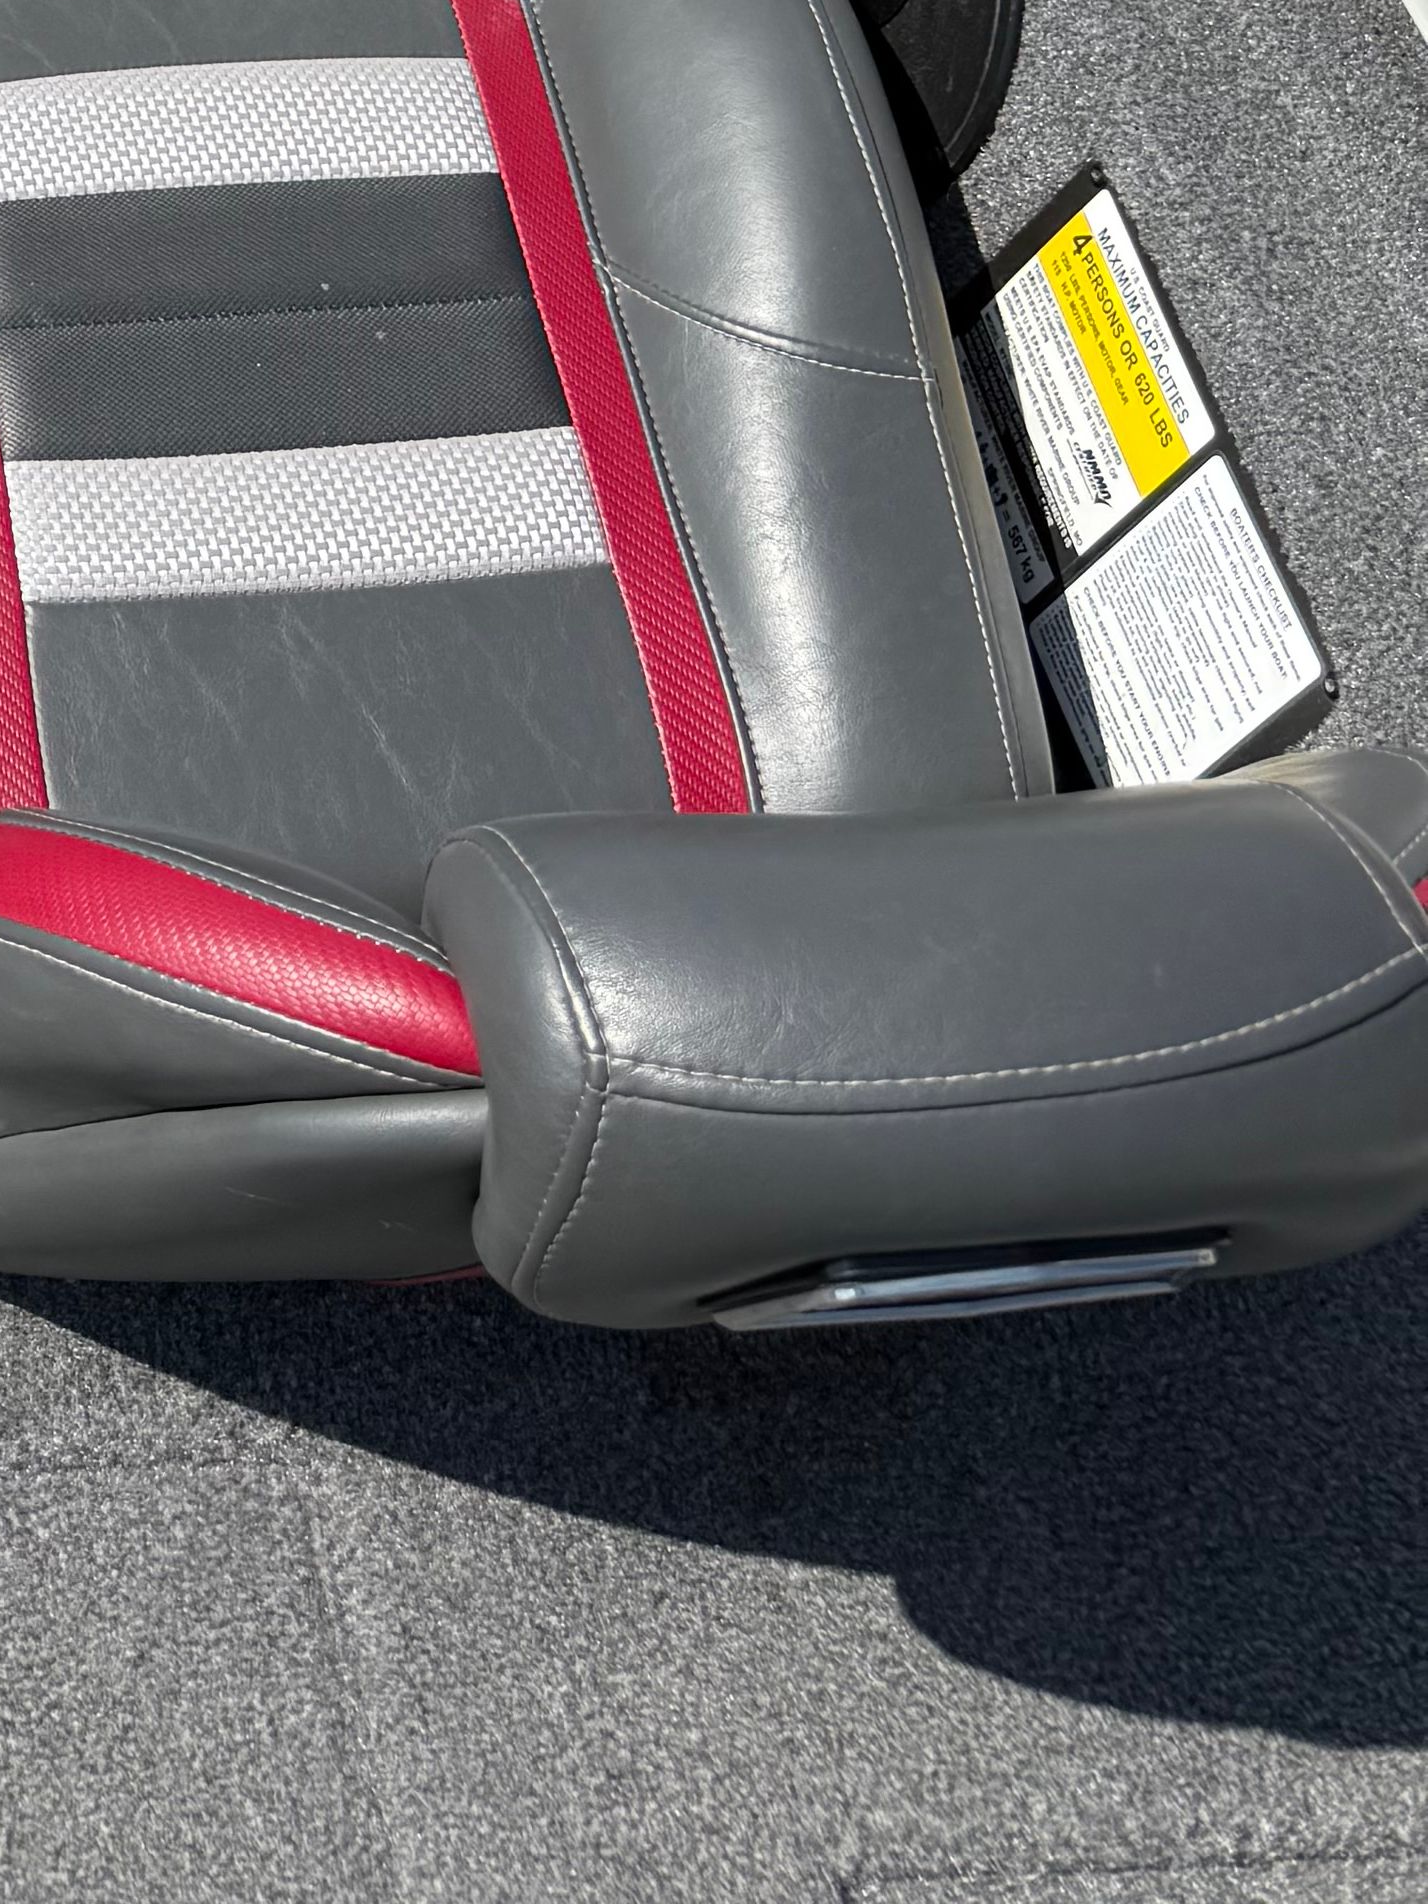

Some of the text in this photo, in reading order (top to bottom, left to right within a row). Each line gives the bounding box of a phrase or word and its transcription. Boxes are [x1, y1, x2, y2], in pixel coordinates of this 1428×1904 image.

[1002, 291, 1063, 431] USING CERTIFIED COMPONENTS
[1009, 284, 1026, 318] MEETS
[1029, 333, 1041, 355] EPA
[1048, 378, 1075, 436] STANDARDS
[1018, 275, 1050, 344] CERTIFICATION
[1025, 269, 1043, 305] SAFETY
[1040, 304, 1066, 360] STANDARDS
[1067, 369, 1086, 405] EFFECT
[1082, 404, 1092, 422] ON
[1089, 420, 1100, 441] THE
[1097, 439, 1112, 467] DATE
[1108, 466, 1118, 483] OF
[1032, 262, 1045, 285] THIS
[1041, 283, 1055, 310] BOAT
[1052, 308, 1075, 356] COMPLIES
[1071, 354, 1085, 381] WITH
[1089, 397, 1107, 432] COAST
[1103, 430, 1122, 467] GUARD
[1067, 223, 1174, 450] 4 PERSONS OR 620 LBS
[1068, 299, 1087, 335] MOTOR
[1096, 226, 1190, 426] MAXIMUM CAPACITIES
[1137, 284, 1155, 318] COAST
[1151, 317, 1170, 353] GUARD
[1023, 377, 1039, 408] WHITE
[1035, 406, 1050, 436] RIVER
[1046, 434, 1065, 473] MARINE
[1061, 470, 1080, 508] GROUP
[1113, 375, 1129, 406] GEAR
[1007, 523, 1036, 585] 567 kg
[1072, 529, 1083, 548] MO
[1193, 484, 1213, 520] CHECK
[1209, 519, 1231, 559] BEFORE
[1227, 558, 1241, 581] YOU
[1237, 579, 1260, 622] LAUNCH
[1257, 621, 1274, 651] YOUR
[1229, 506, 1291, 631] BOATER'S CHECKLIST
[1082, 585, 1100, 619] CHECK
[1097, 618, 1117, 657] BEFORE
[1114, 657, 1127, 680] YOU
[1124, 679, 1141, 710] START
[1138, 710, 1154, 739] YOUR
